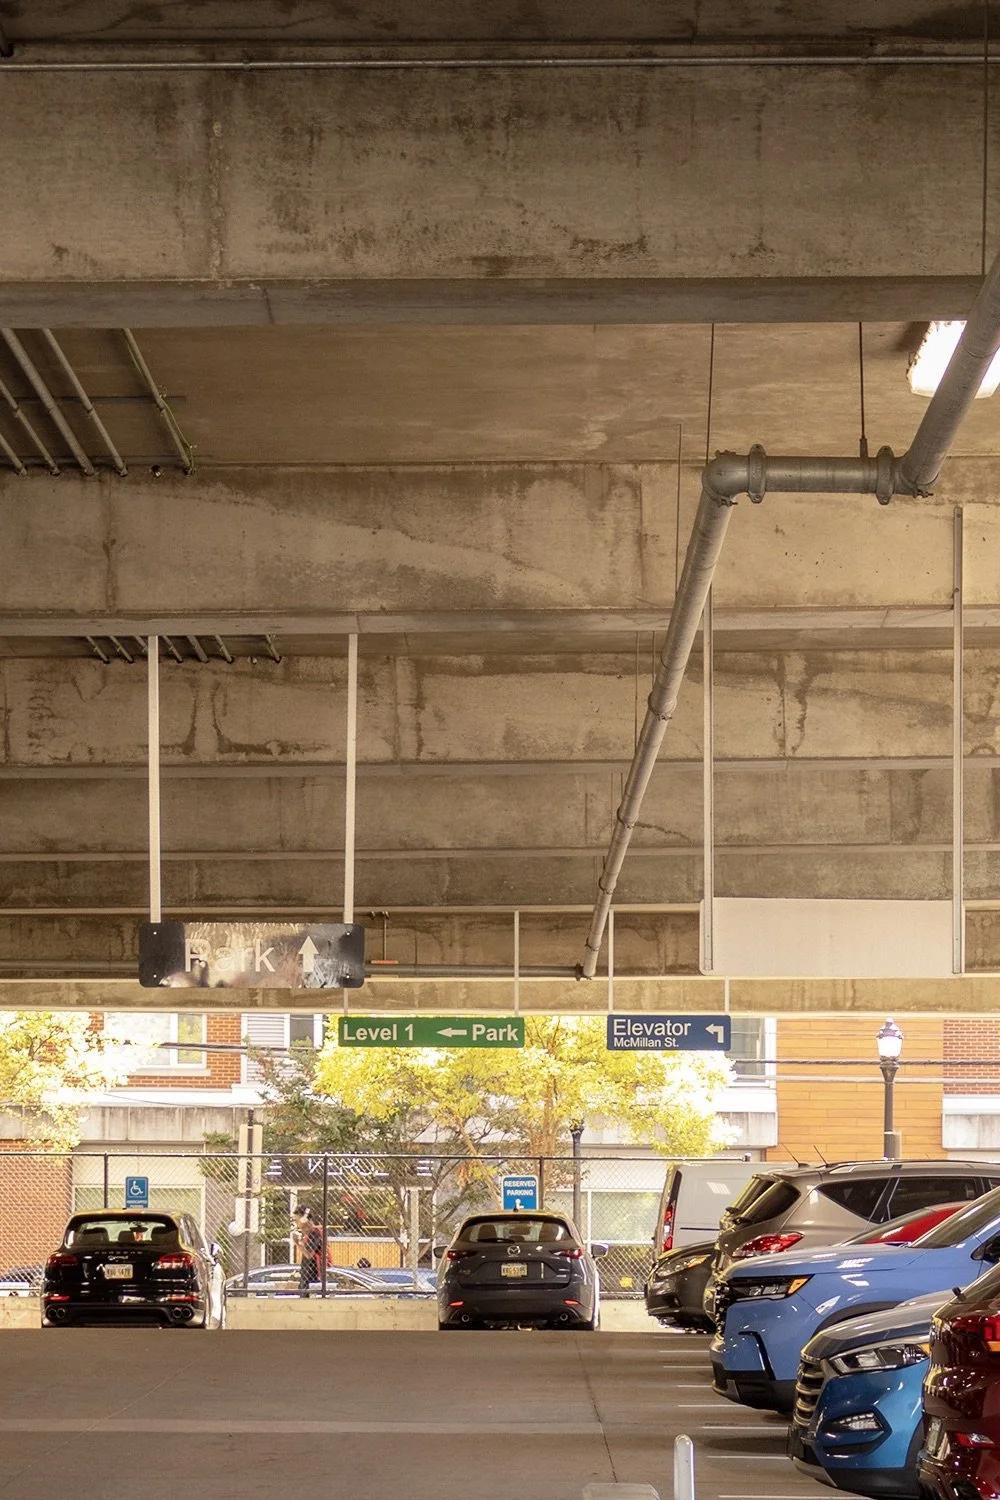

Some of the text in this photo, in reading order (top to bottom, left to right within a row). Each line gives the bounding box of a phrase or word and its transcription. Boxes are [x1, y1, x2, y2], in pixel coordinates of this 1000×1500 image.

[185, 938, 276, 972] Park
[343, 1023, 519, 1041] Level 1 Park
[613, 1019, 691, 1037] Elevator
[614, 1037, 679, 1048] McMillan St.
